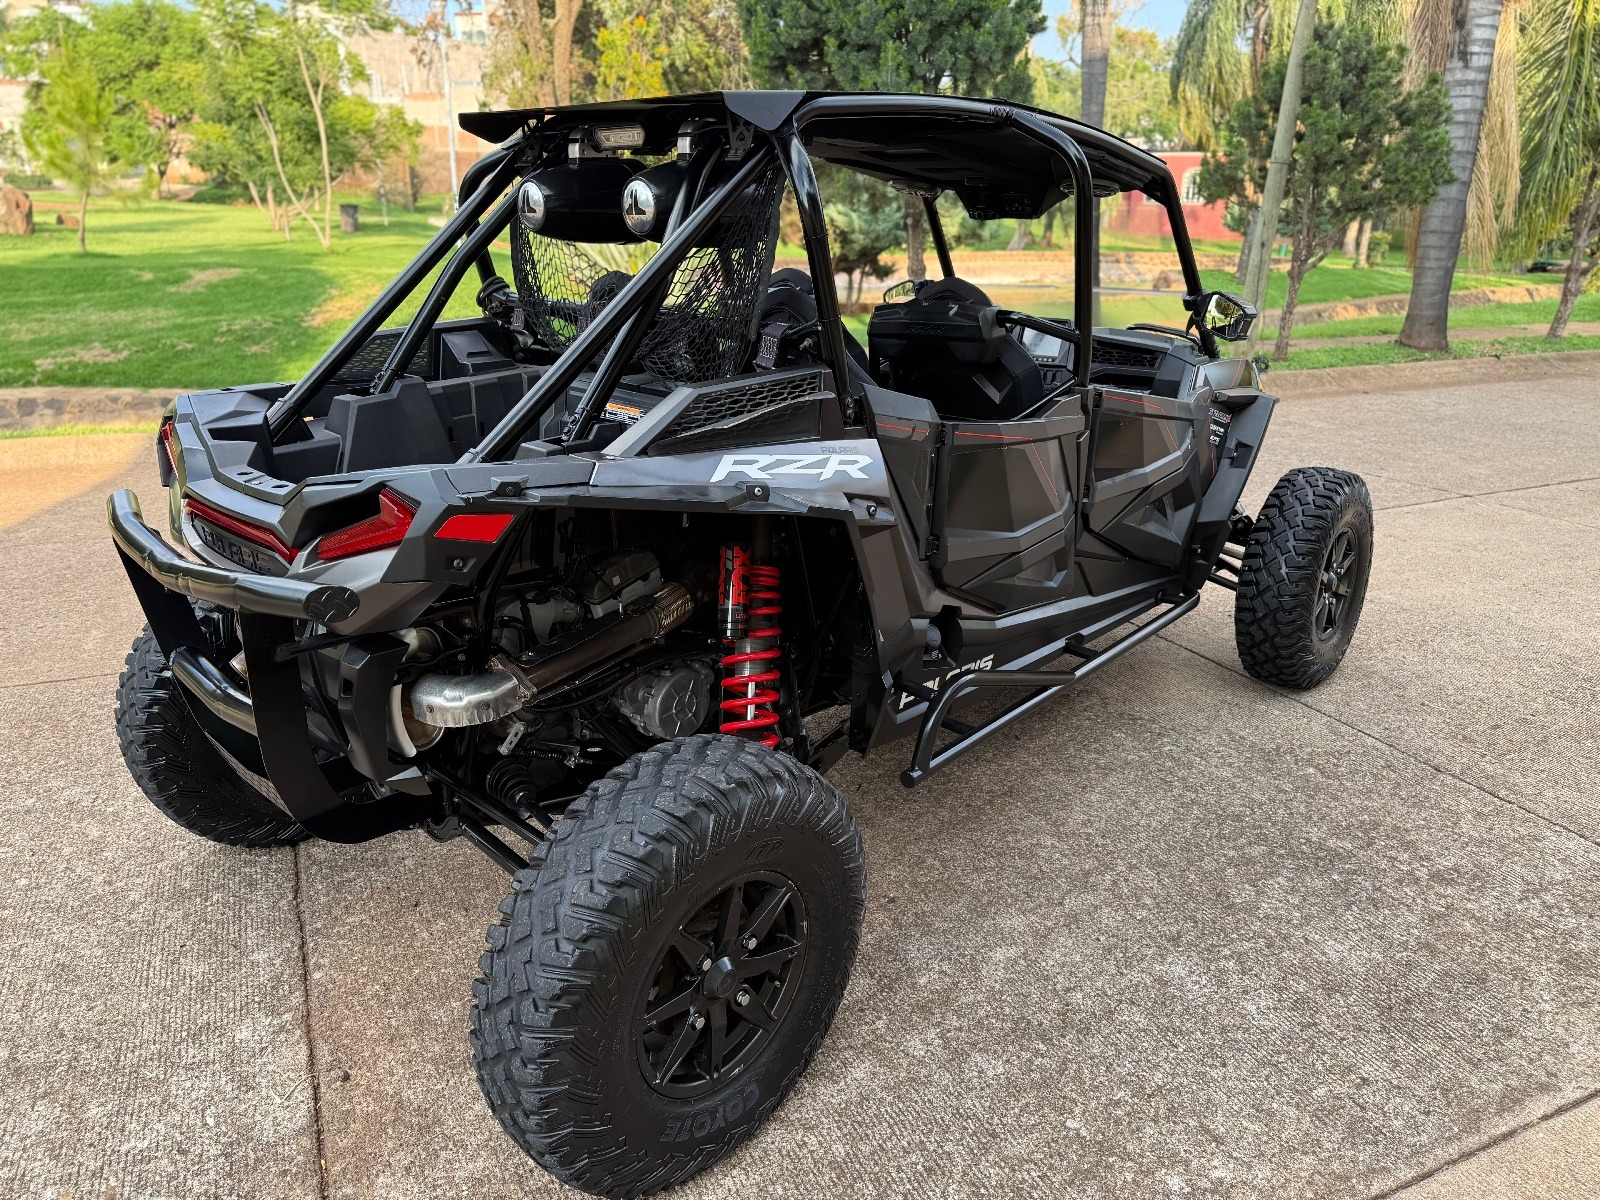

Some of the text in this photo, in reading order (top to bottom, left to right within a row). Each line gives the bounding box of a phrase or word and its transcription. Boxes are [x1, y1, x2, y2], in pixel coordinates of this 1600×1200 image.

[821, 446, 859, 454] POLARIS
[709, 454, 873, 483] RZR
[660, 1082, 760, 1142] COYOTE
